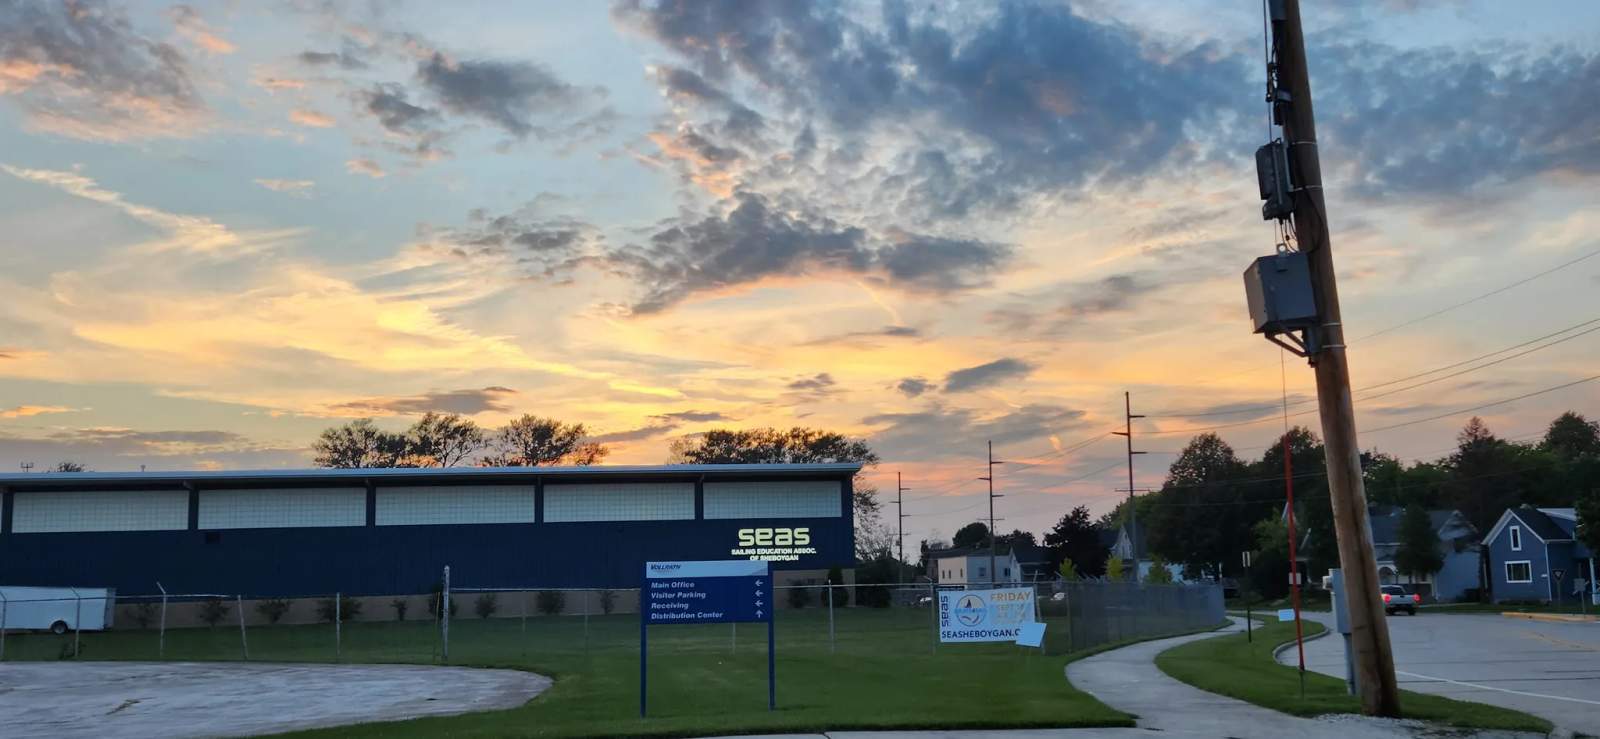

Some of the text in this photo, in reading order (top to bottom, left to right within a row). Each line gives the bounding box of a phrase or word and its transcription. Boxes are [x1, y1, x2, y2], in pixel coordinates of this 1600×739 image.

[738, 527, 810, 547] seas
[651, 581, 670, 589] Main
[677, 591, 706, 599] Parking
[991, 592, 1030, 601] FRIDAY
[651, 602, 689, 610] Receiving
[651, 611, 724, 620] Distribution Center
